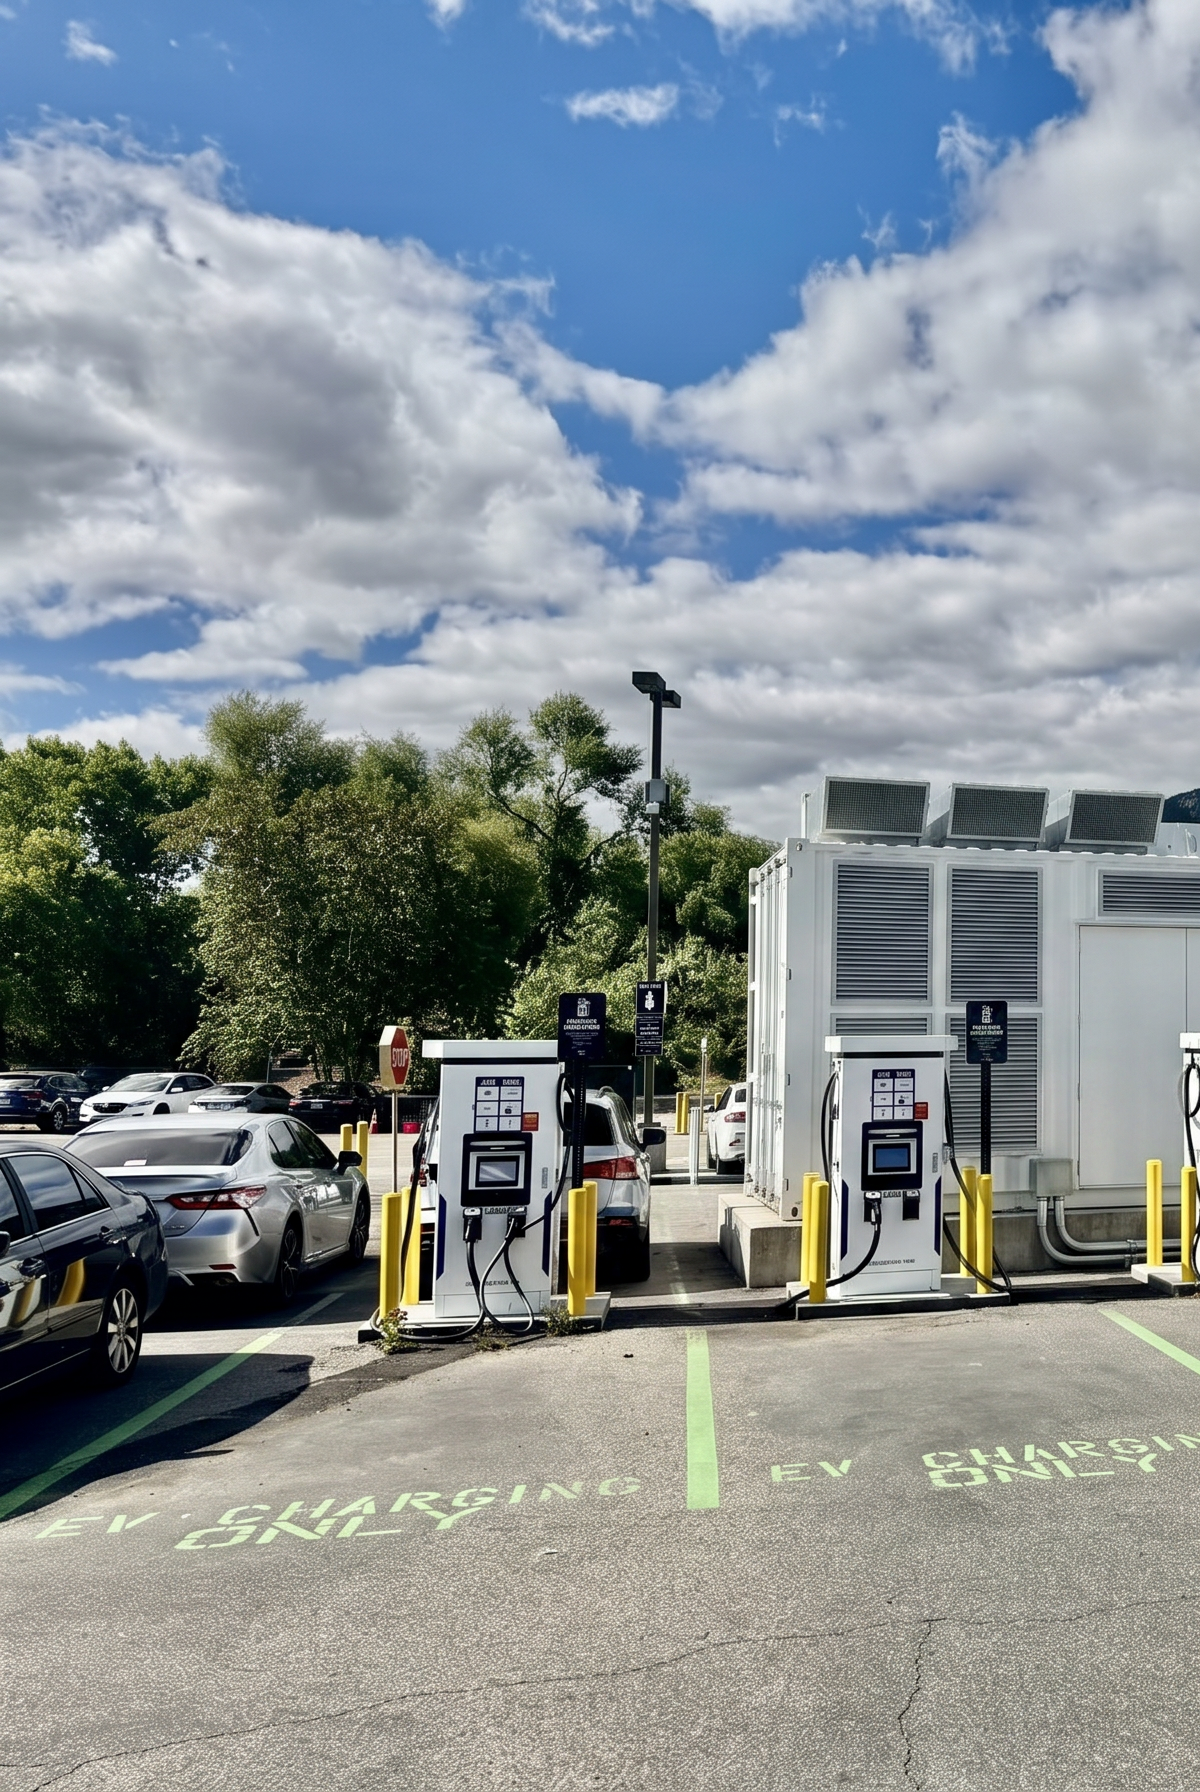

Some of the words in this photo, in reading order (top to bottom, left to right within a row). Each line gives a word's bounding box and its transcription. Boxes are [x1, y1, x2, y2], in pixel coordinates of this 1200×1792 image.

[392, 1047, 409, 1067] STOP
[771, 1459, 853, 1484] EV
[928, 1453, 1158, 1488] ONLY
[34, 1512, 159, 1540] EV
[217, 1476, 642, 1526] CHARGING
[173, 1508, 483, 1551] ONLY
